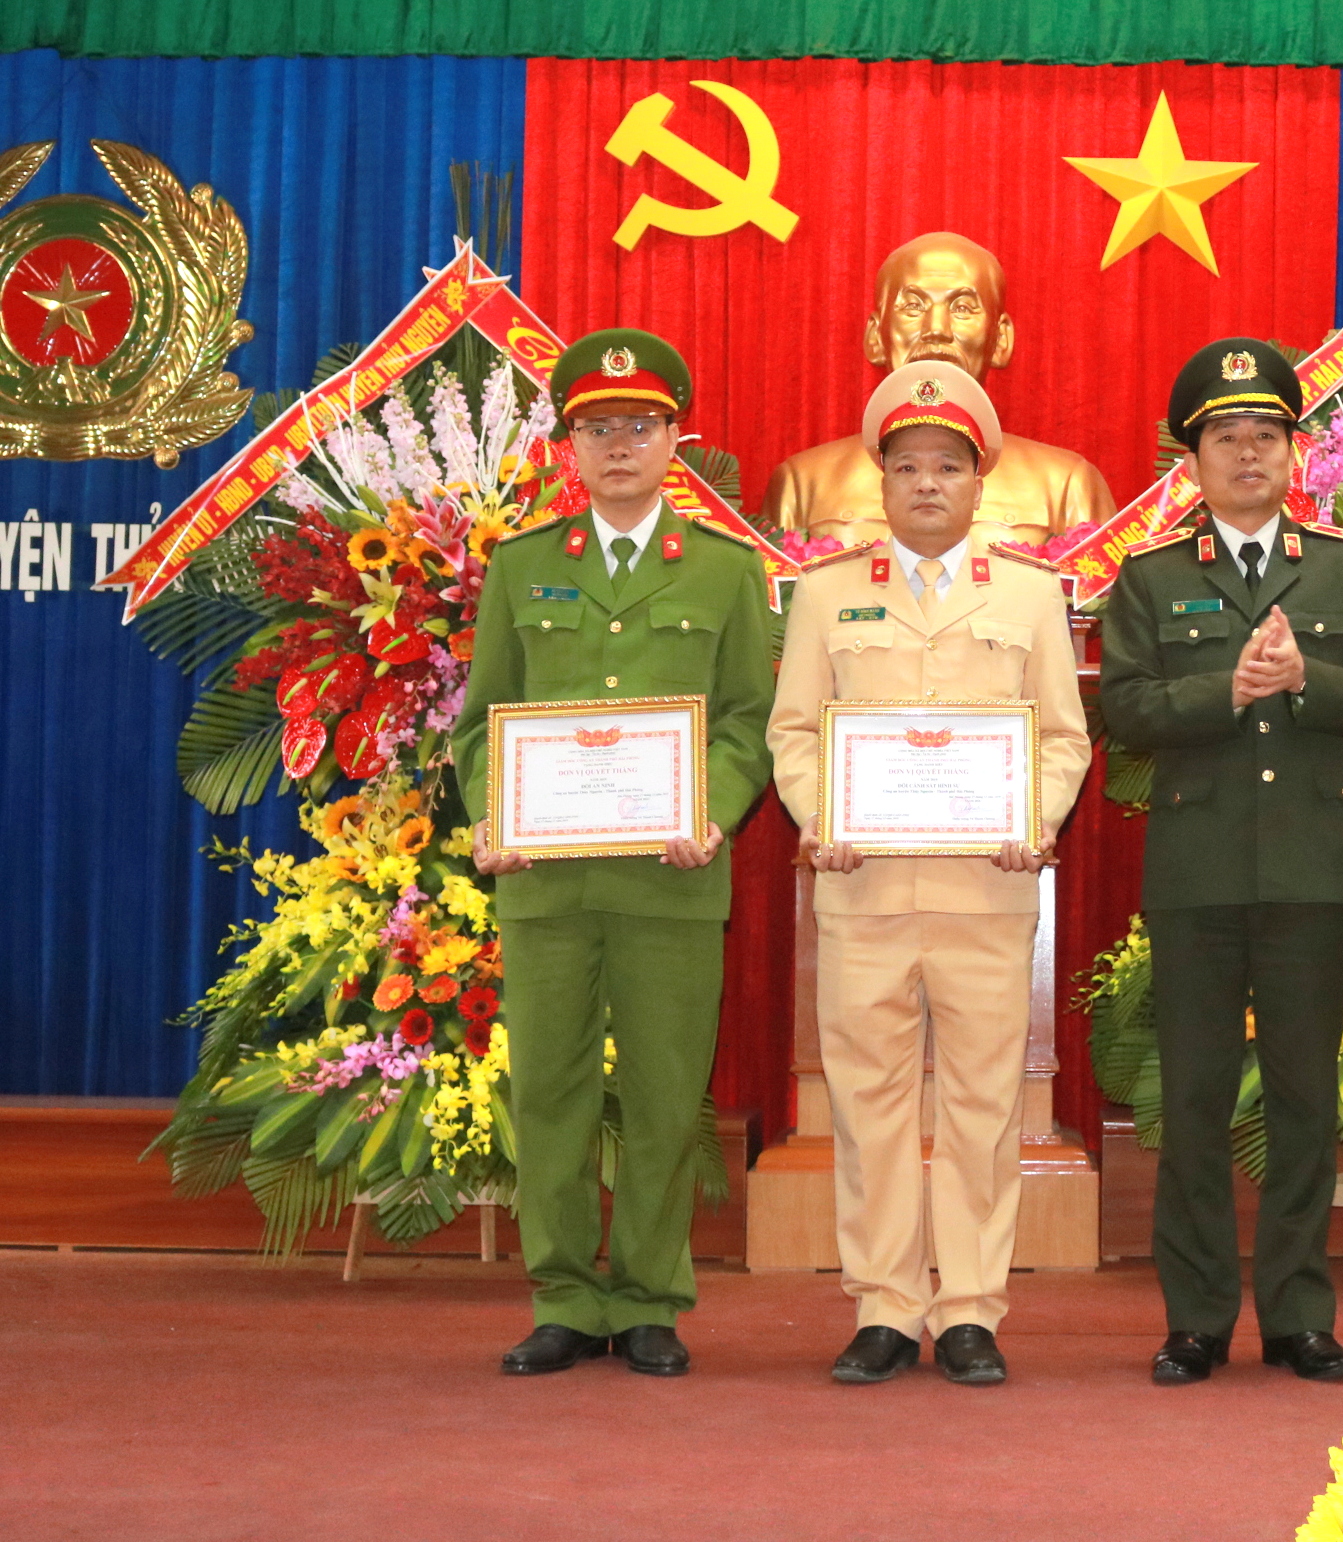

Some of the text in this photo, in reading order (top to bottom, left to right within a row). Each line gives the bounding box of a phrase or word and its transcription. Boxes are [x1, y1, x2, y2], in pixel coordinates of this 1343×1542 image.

[374, 342, 411, 378] THỦY
[399, 304, 452, 356] NGUYÊN
[1137, 504, 1168, 532] ỦY
[1168, 473, 1201, 507] GIÁ
[1309, 358, 1343, 391] HẢI
